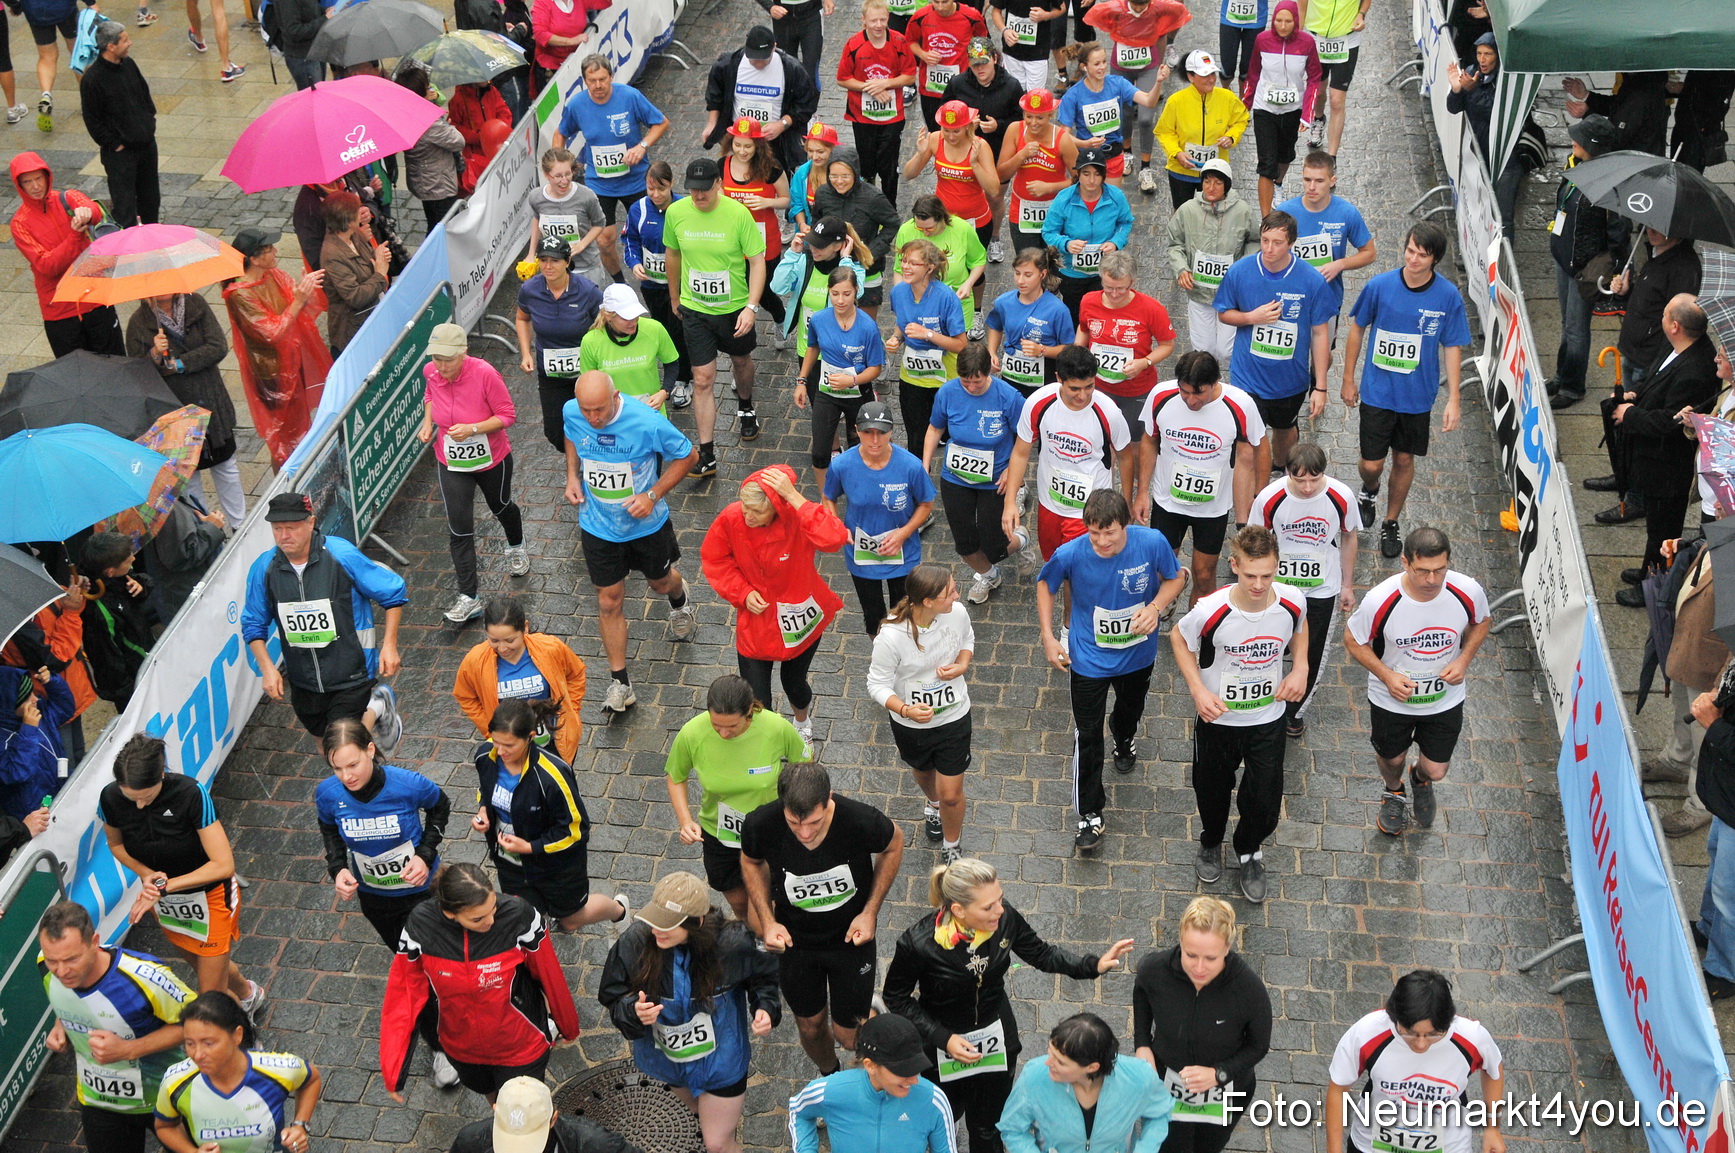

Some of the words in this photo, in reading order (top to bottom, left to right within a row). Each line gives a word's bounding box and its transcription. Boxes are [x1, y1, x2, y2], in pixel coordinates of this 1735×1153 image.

[1230, 2, 1255, 15] 5157
[1008, 22, 1035, 35] 5045
[1120, 47, 1148, 61] 5079
[1319, 41, 1345, 53] 5097
[742, 86, 778, 96] STAEDTLER
[1266, 90, 1296, 103] 5133
[739, 107, 769, 122] 5088
[1088, 108, 1118, 125] 5208
[339, 137, 377, 162] DÉESSE
[1188, 149, 1216, 162] 3418
[595, 152, 625, 167] 5152
[941, 167, 964, 176] DURST
[1023, 210, 1046, 222] 510
[542, 224, 575, 236] 5053
[1293, 243, 1328, 259] 5219
[645, 257, 667, 272] 510
[1196, 261, 1230, 277] 5085
[458, 280, 471, 300] Ihr
[692, 279, 726, 294] 5161
[699, 295, 719, 303] Martin
[1255, 327, 1294, 347] 5115
[1260, 345, 1283, 355] Thomas
[1378, 341, 1416, 359] 5019
[906, 356, 942, 371] 5018
[1006, 358, 1040, 375] 5054
[1093, 352, 1128, 371] 5221
[1385, 358, 1405, 368] Tobias
[365, 343, 417, 415] Event-Leit-Systeme
[354, 445, 372, 477] Fun
[373, 430, 382, 450] &
[383, 391, 411, 439] Action
[411, 377, 421, 397] in
[1165, 428, 1210, 443] GERHART
[448, 443, 486, 460] 5228
[588, 444, 634, 454] firmenlauf
[1059, 443, 1088, 454] JANIG
[1184, 438, 1216, 450] JANIG
[357, 442, 395, 502] sicheren
[951, 454, 989, 476] 5222
[380, 471, 400, 502] Service
[588, 471, 627, 489] 5217
[1173, 473, 1214, 494] 5195
[1051, 477, 1086, 501] 5145
[1176, 491, 1204, 503] Jewgeni
[1281, 521, 1323, 533] GERHART
[1300, 526, 1328, 536] JANIG
[1278, 560, 1321, 577] 5198
[1284, 578, 1312, 588] Andreas
[286, 612, 330, 632] 5028
[781, 606, 817, 632] 5170
[1100, 618, 1132, 635] 507
[301, 634, 320, 643] Erwin
[1395, 632, 1446, 647] GERHART
[1418, 639, 1453, 649] JANIG
[1223, 642, 1275, 654] GERHART
[502, 687, 545, 698] TECHNOLOGY
[1225, 680, 1273, 701] 5196
[1413, 678, 1445, 695] 176
[911, 685, 956, 708] 5076
[1407, 695, 1436, 704] Richard
[1235, 701, 1261, 709] Patrick
[340, 814, 400, 831] HUBER
[353, 828, 399, 837] TECHNOLOGY
[364, 855, 411, 876] 5084
[792, 877, 849, 900] 5215
[812, 895, 836, 906] MAX
[158, 901, 206, 920] 5199
[1589, 770, 1612, 870] TUI
[1602, 849, 1698, 1153] ReiseCenter
[135, 964, 187, 1004] BOCK
[58, 1007, 94, 1023] TEAM
[656, 1024, 708, 1050] 5225
[260, 1056, 302, 1070] BOCK
[83, 1069, 137, 1097] 5049
[1379, 1079, 1446, 1095] GERHART
[201, 1115, 239, 1127] TEAM
[200, 1123, 263, 1142] BOCK
[1379, 1126, 1438, 1150] 5172
